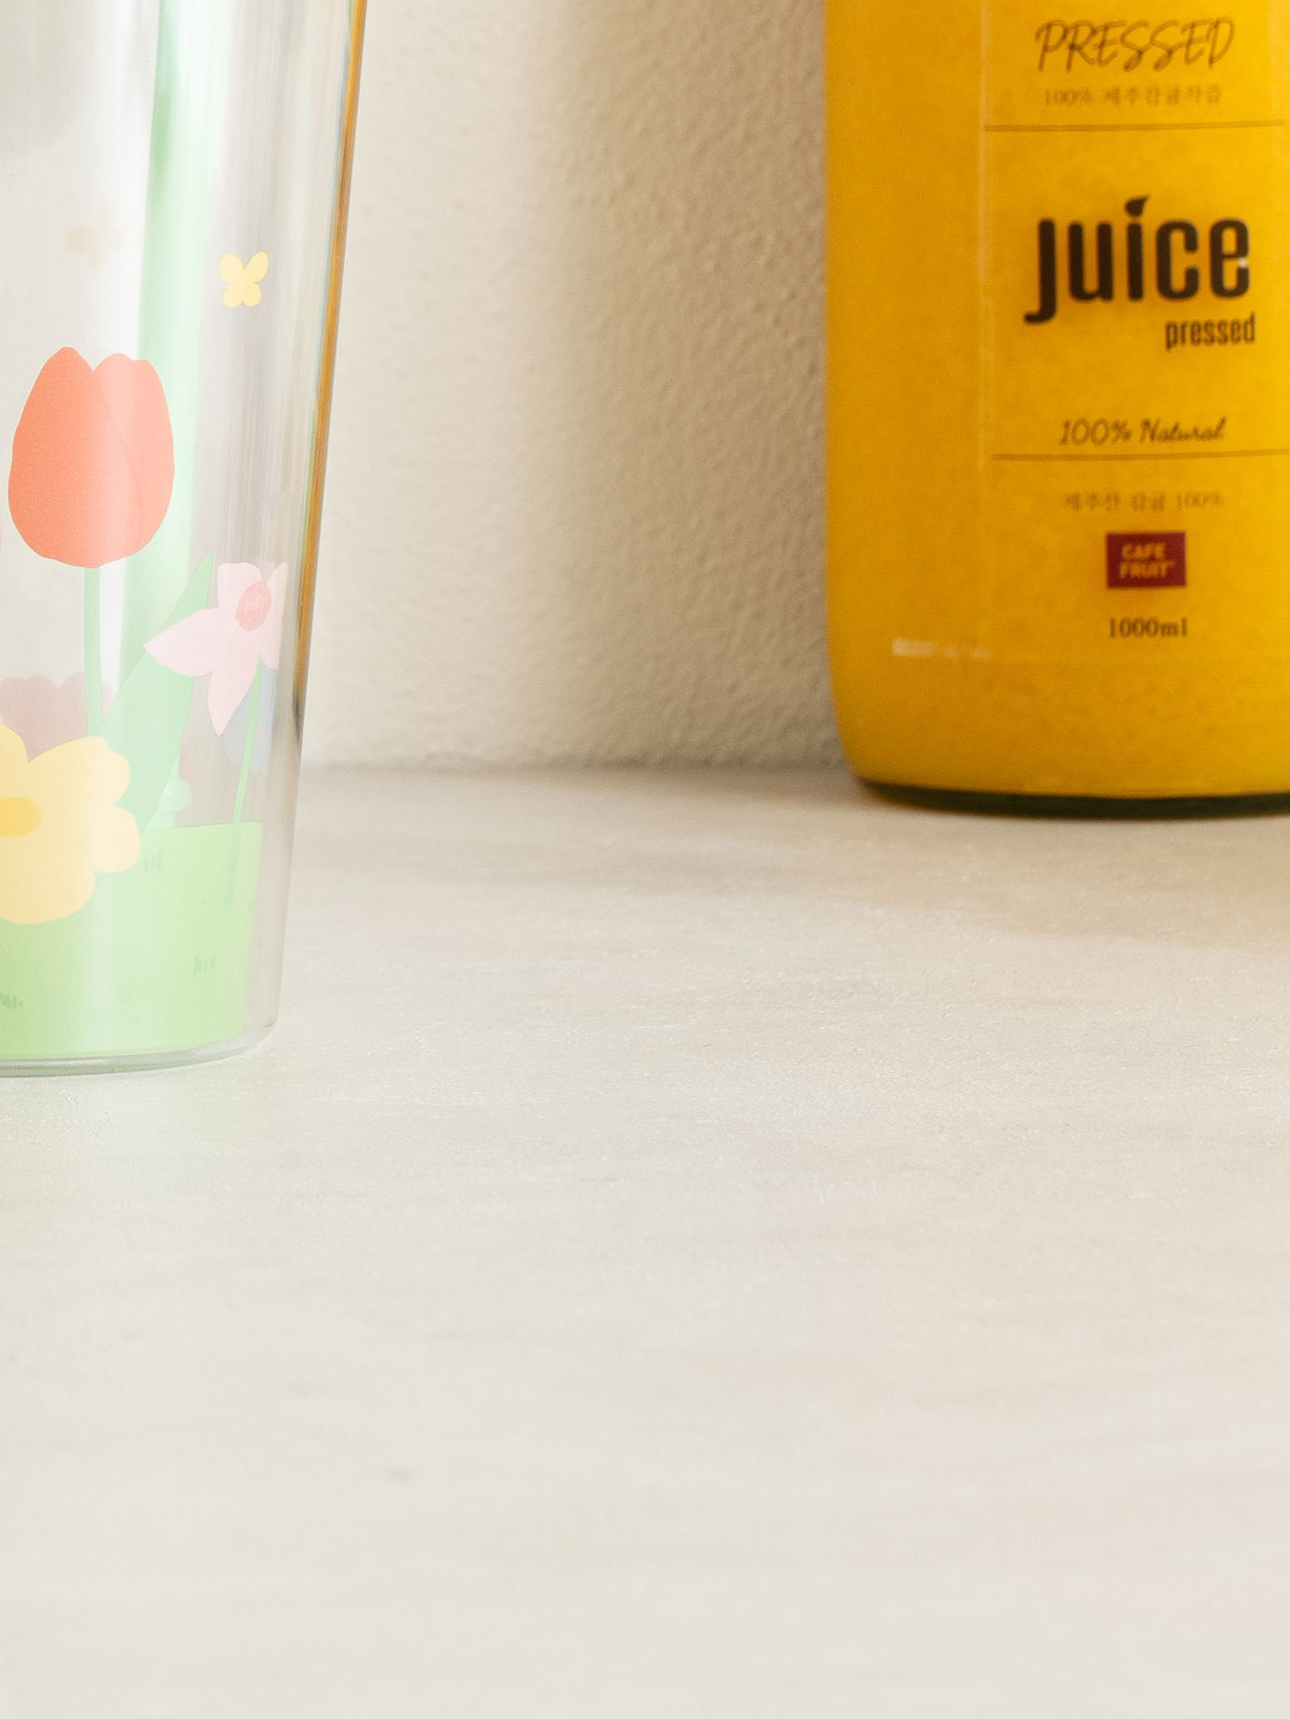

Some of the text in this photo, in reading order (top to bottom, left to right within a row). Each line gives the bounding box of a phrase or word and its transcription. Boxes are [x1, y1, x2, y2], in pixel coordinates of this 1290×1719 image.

[1035, 19, 1235, 72] PRESSED
[1023, 195, 1250, 325] juice
[1165, 312, 1256, 351] pressed
[1058, 415, 1227, 446] 100% Natural
[1121, 542, 1167, 561] CAFE
[1109, 617, 1188, 638] 1000ml
